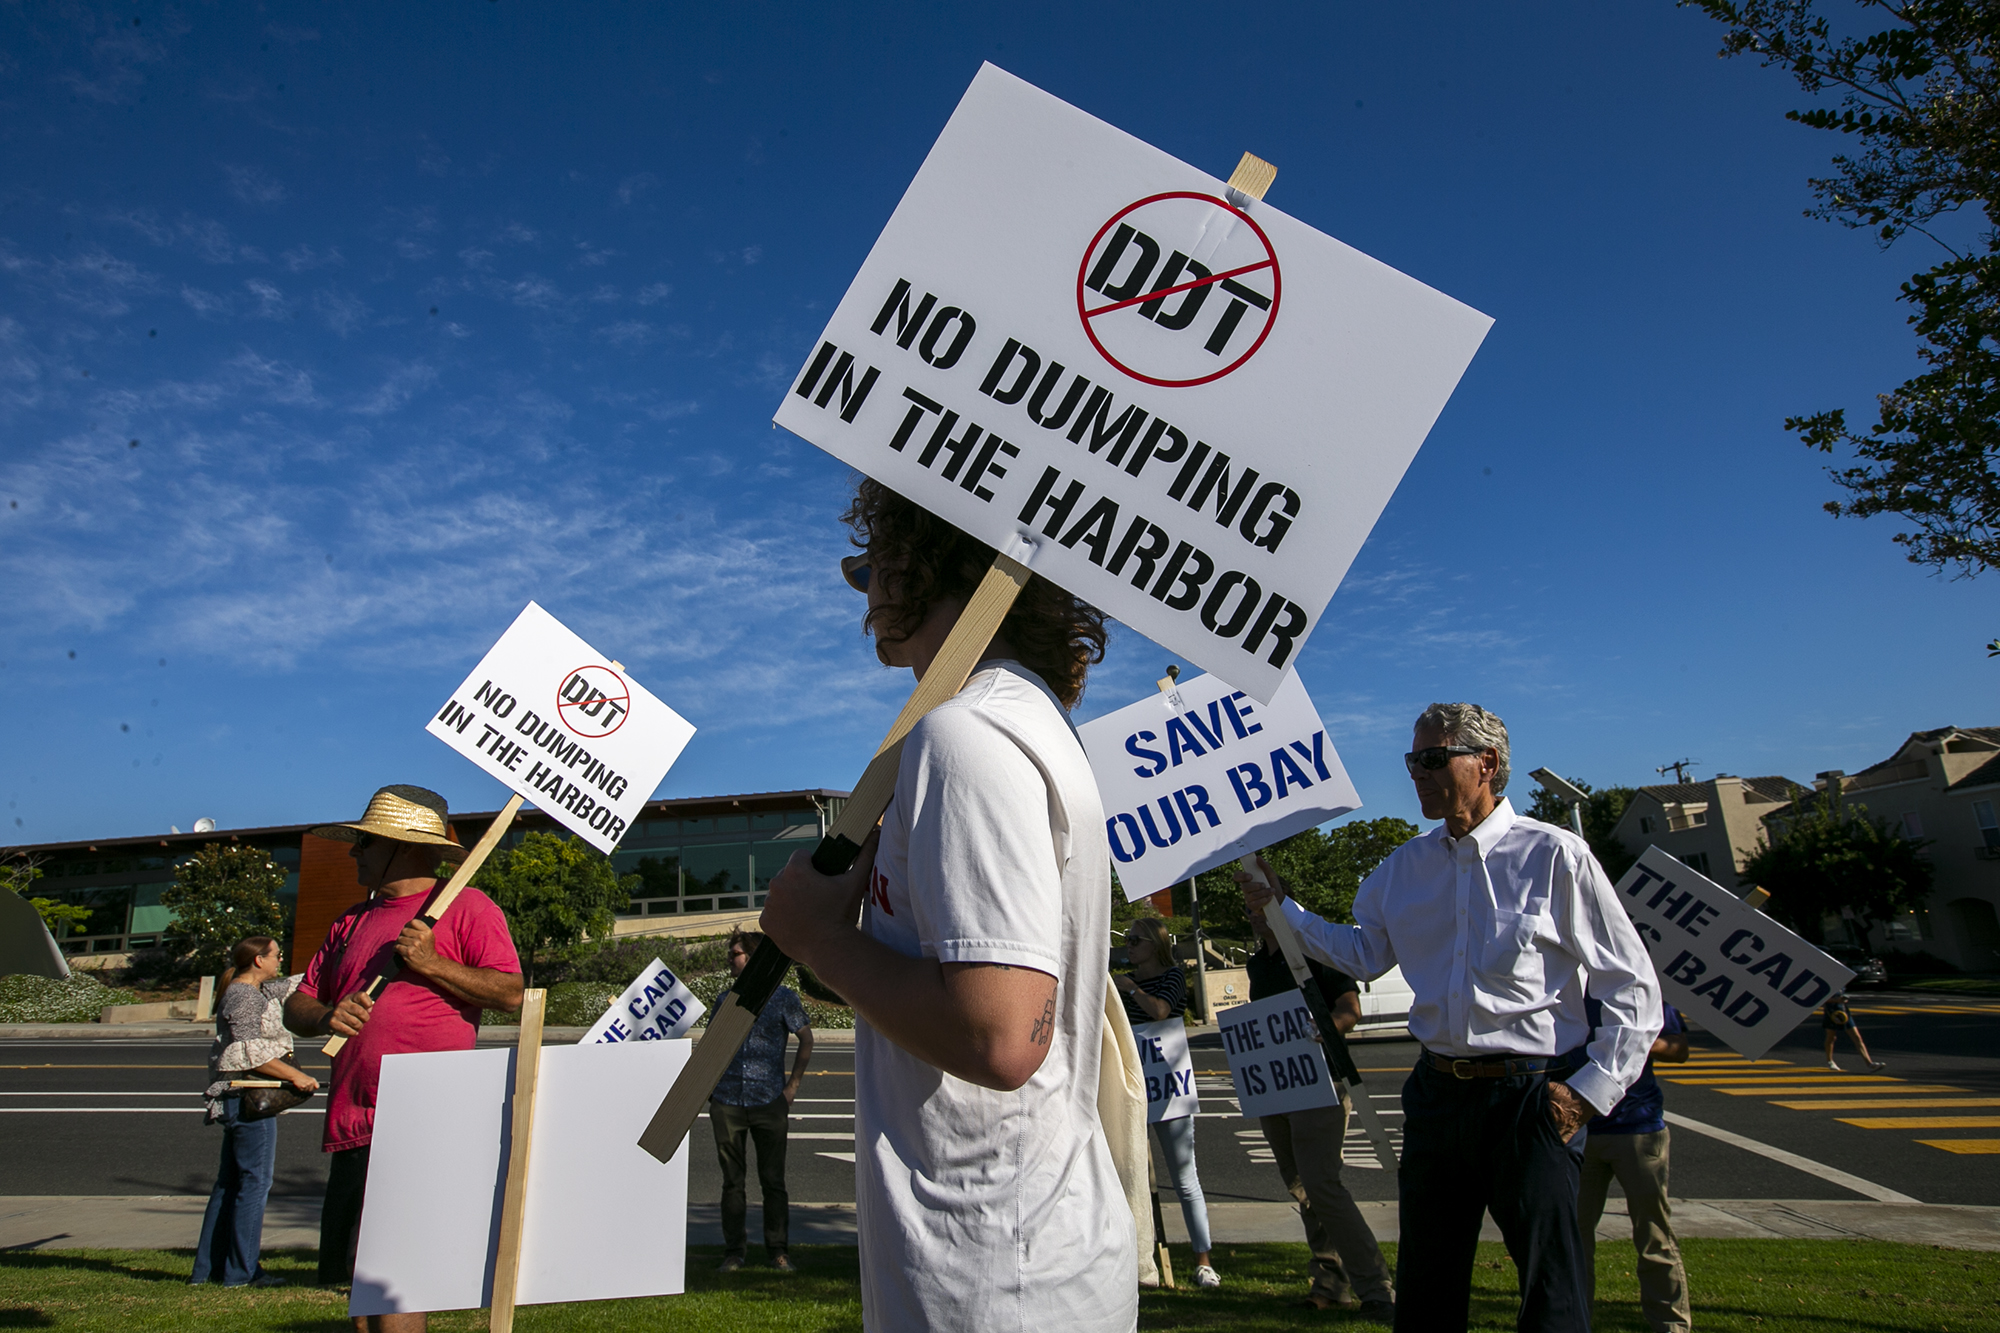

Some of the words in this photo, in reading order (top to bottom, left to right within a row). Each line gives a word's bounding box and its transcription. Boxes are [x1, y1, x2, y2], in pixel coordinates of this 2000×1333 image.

[1085, 222, 1272, 356] DDT
[870, 277, 976, 370] NO
[979, 337, 1301, 554] DUMPING
[796, 341, 881, 424] IN
[889, 386, 1021, 503] THE
[1017, 465, 1308, 670] HARBOR
[473, 679, 517, 719] NO
[515, 710, 629, 802] DUMPING
[560, 674, 627, 729] DDT
[1125, 690, 1264, 778] SAVE
[438, 700, 475, 734] IN
[475, 723, 529, 772] THE
[524, 761, 627, 843] HARBOR
[1106, 785, 1222, 863] OUR
[1226, 730, 1332, 814] BAY
[1626, 862, 1721, 938] THE
[1719, 928, 1832, 1008] CAD
[628, 969, 677, 1020] CAD
[1221, 1019, 1265, 1055] THE
[1662, 949, 1770, 1028] BAD
[1145, 1069, 1191, 1103] BAY
[1241, 1064, 1267, 1096] IS
[1269, 1053, 1319, 1091] BAD
